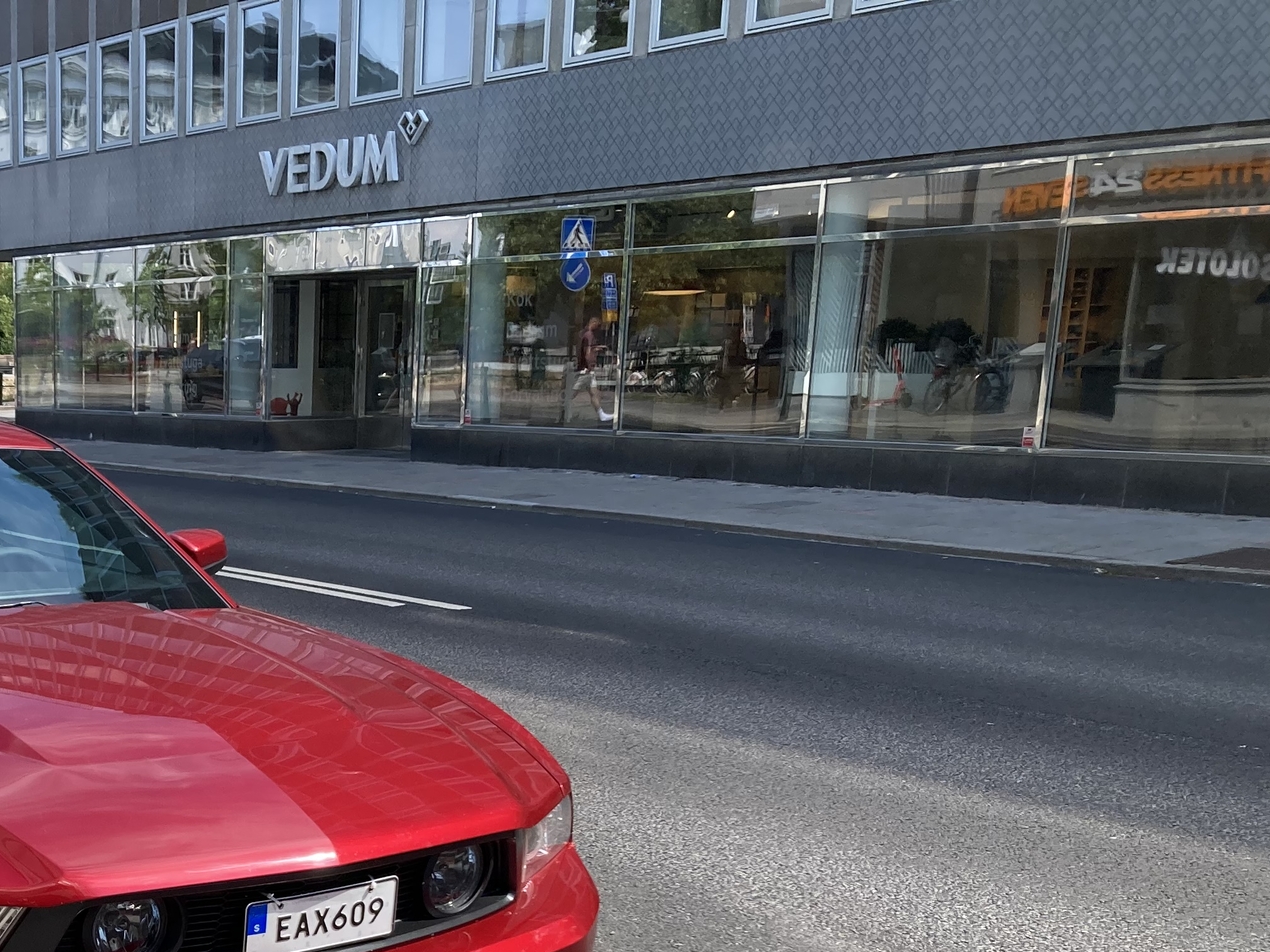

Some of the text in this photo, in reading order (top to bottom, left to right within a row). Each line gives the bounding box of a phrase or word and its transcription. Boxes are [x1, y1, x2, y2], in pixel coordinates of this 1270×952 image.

[258, 130, 399, 196] VEDUM
[253, 897, 384, 943] S EAX609
